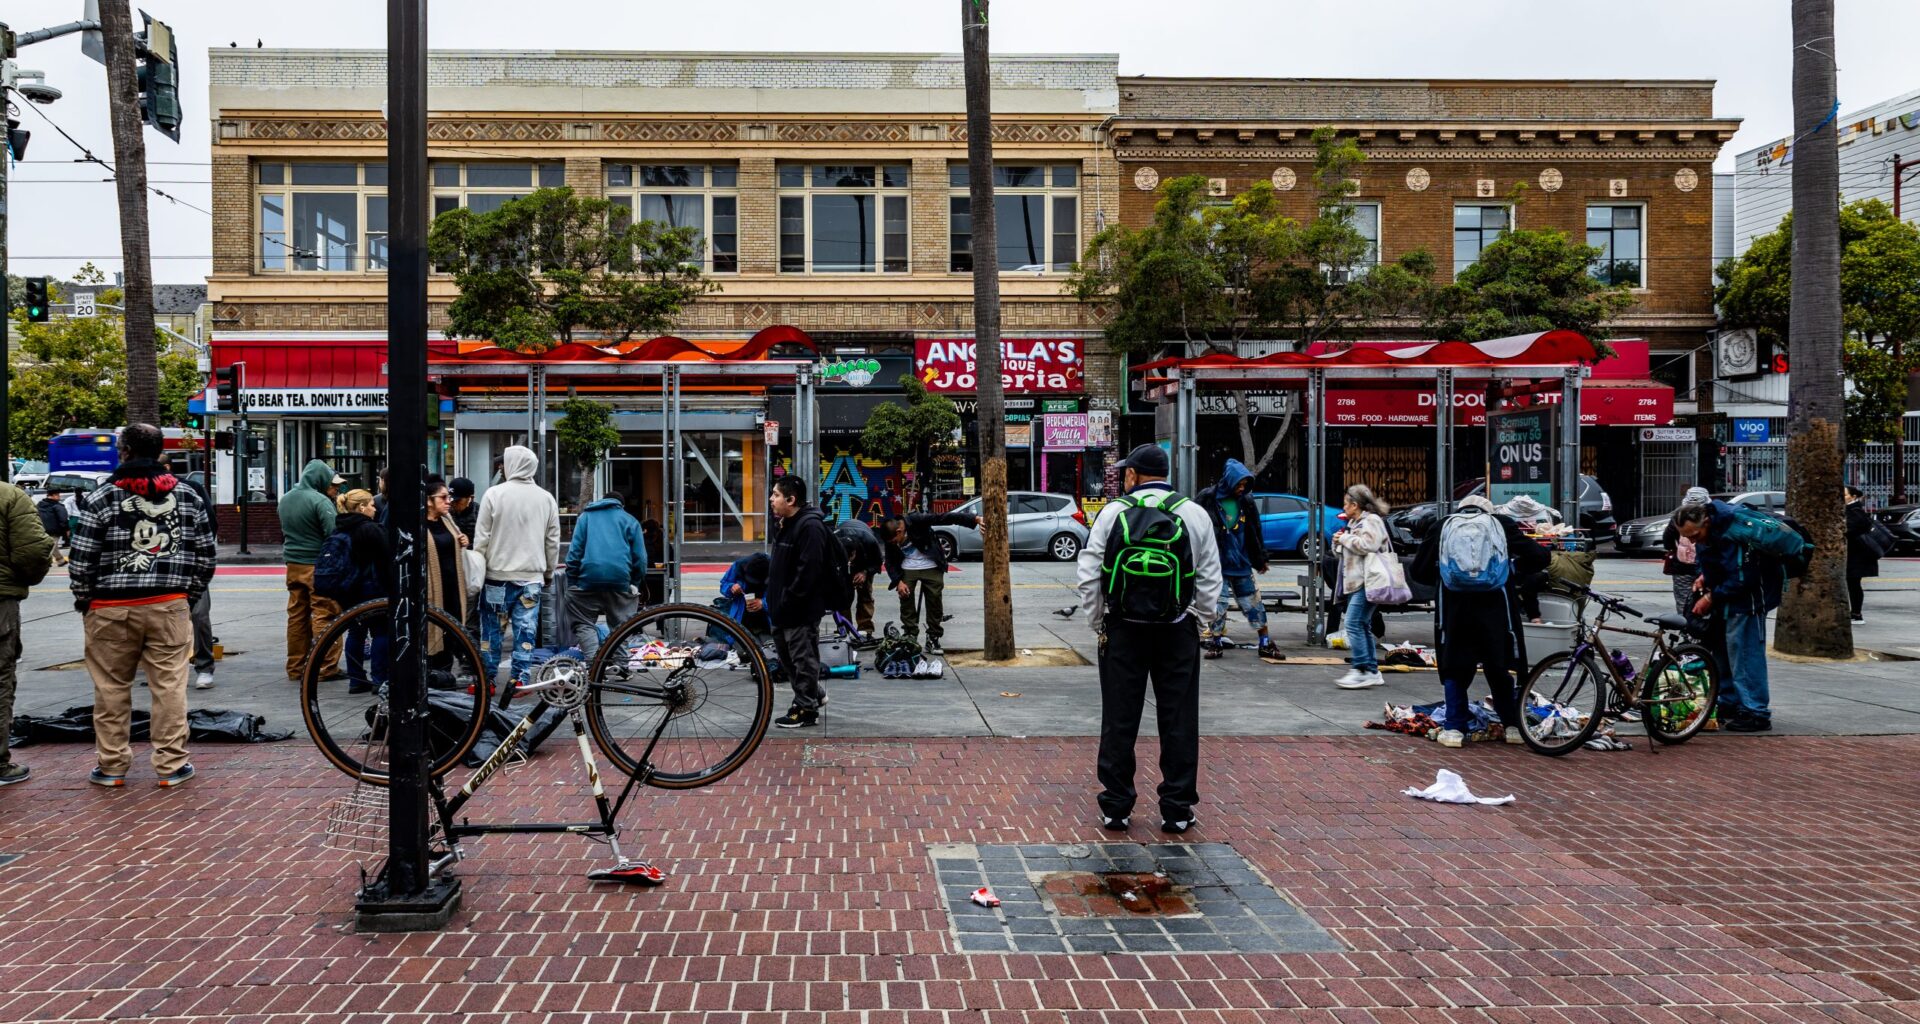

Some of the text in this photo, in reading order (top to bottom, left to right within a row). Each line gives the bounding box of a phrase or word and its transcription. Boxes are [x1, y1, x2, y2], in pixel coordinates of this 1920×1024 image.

[77, 306, 93, 315] 20
[926, 341, 1076, 364] ANLA'S
[966, 359, 1036, 373] BIQUE
[934, 369, 1068, 389] Joeria
[259, 393, 283, 407] BEAR
[287, 393, 308, 407] TEA.
[311, 393, 344, 407] DONUT
[346, 393, 352, 406] &
[355, 393, 389, 407] CHINES
[1004, 414, 1031, 422] COPIAS
[1046, 416, 1086, 427] PERFUMERIA
[1502, 416, 1539, 428] Samsung
[1048, 428, 1080, 440] Judith
[1740, 422, 1765, 433] vigo
[1500, 428, 1542, 443] Galaxy 5G
[1500, 443, 1542, 463] ON US
